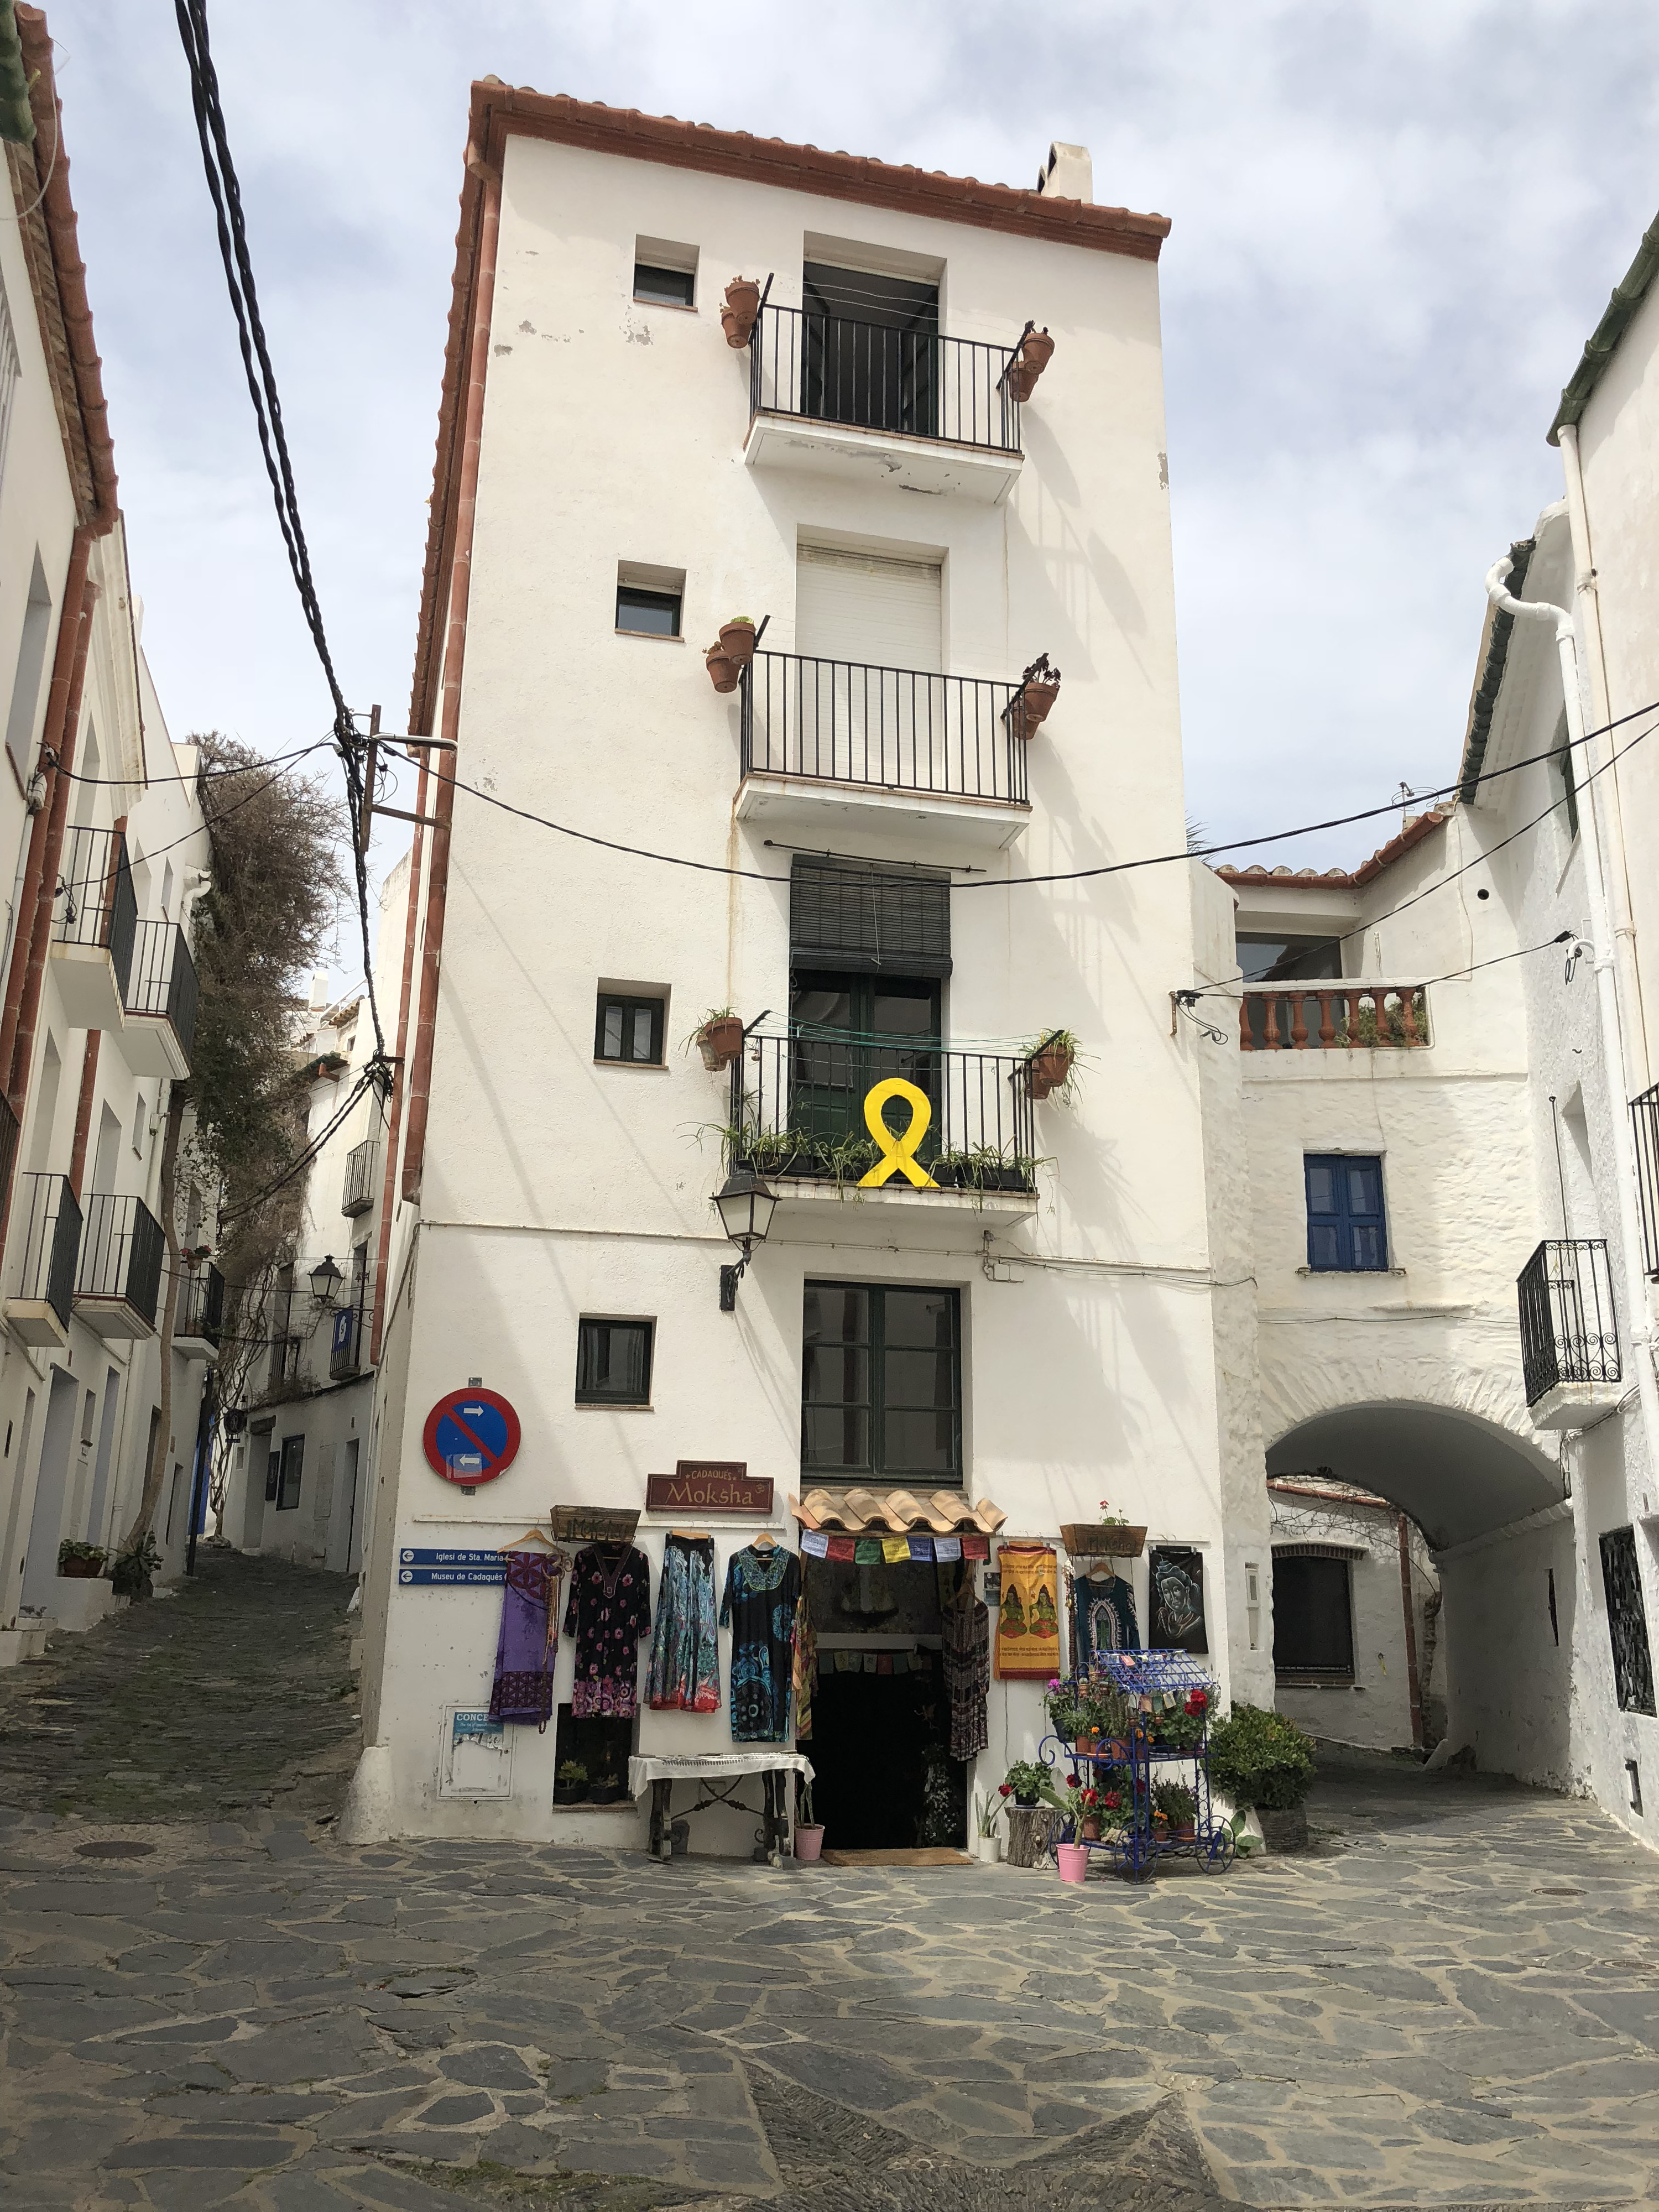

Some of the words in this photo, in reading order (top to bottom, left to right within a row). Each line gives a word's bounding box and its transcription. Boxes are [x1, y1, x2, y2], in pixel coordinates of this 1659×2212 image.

[691, 1469, 732, 1481] CADAQUÉS
[665, 1481, 754, 1505] Moksha
[436, 1552, 455, 1562] Iglesi
[468, 1572, 503, 1582] Cadaqués
[456, 1713, 489, 1721] CONCE
